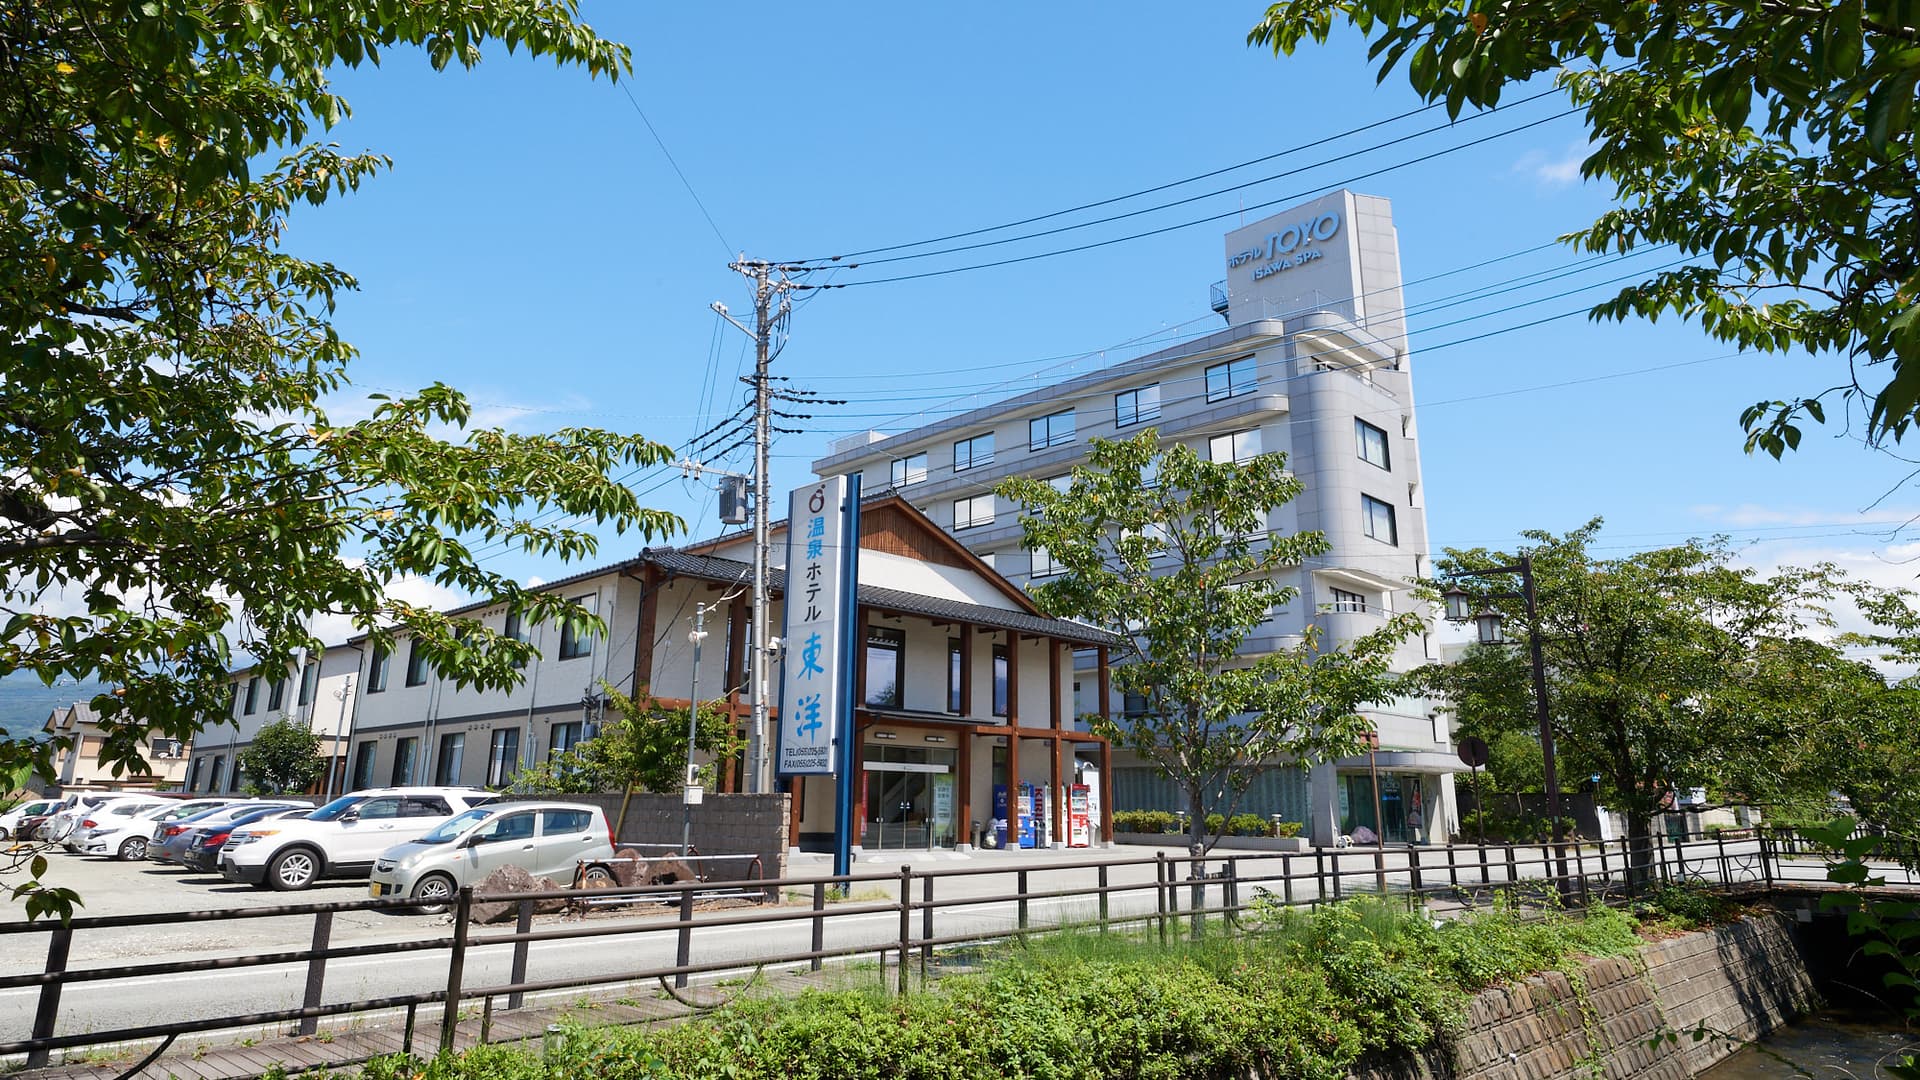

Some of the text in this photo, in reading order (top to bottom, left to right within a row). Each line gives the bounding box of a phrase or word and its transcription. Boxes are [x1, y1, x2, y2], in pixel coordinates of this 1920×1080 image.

[1229, 210, 1341, 268] ホテル TOYO
[1252, 249, 1322, 281] ISAWA SPA
[804, 516, 825, 622] 温泉ホテル
[795, 632, 824, 745] 東洋
